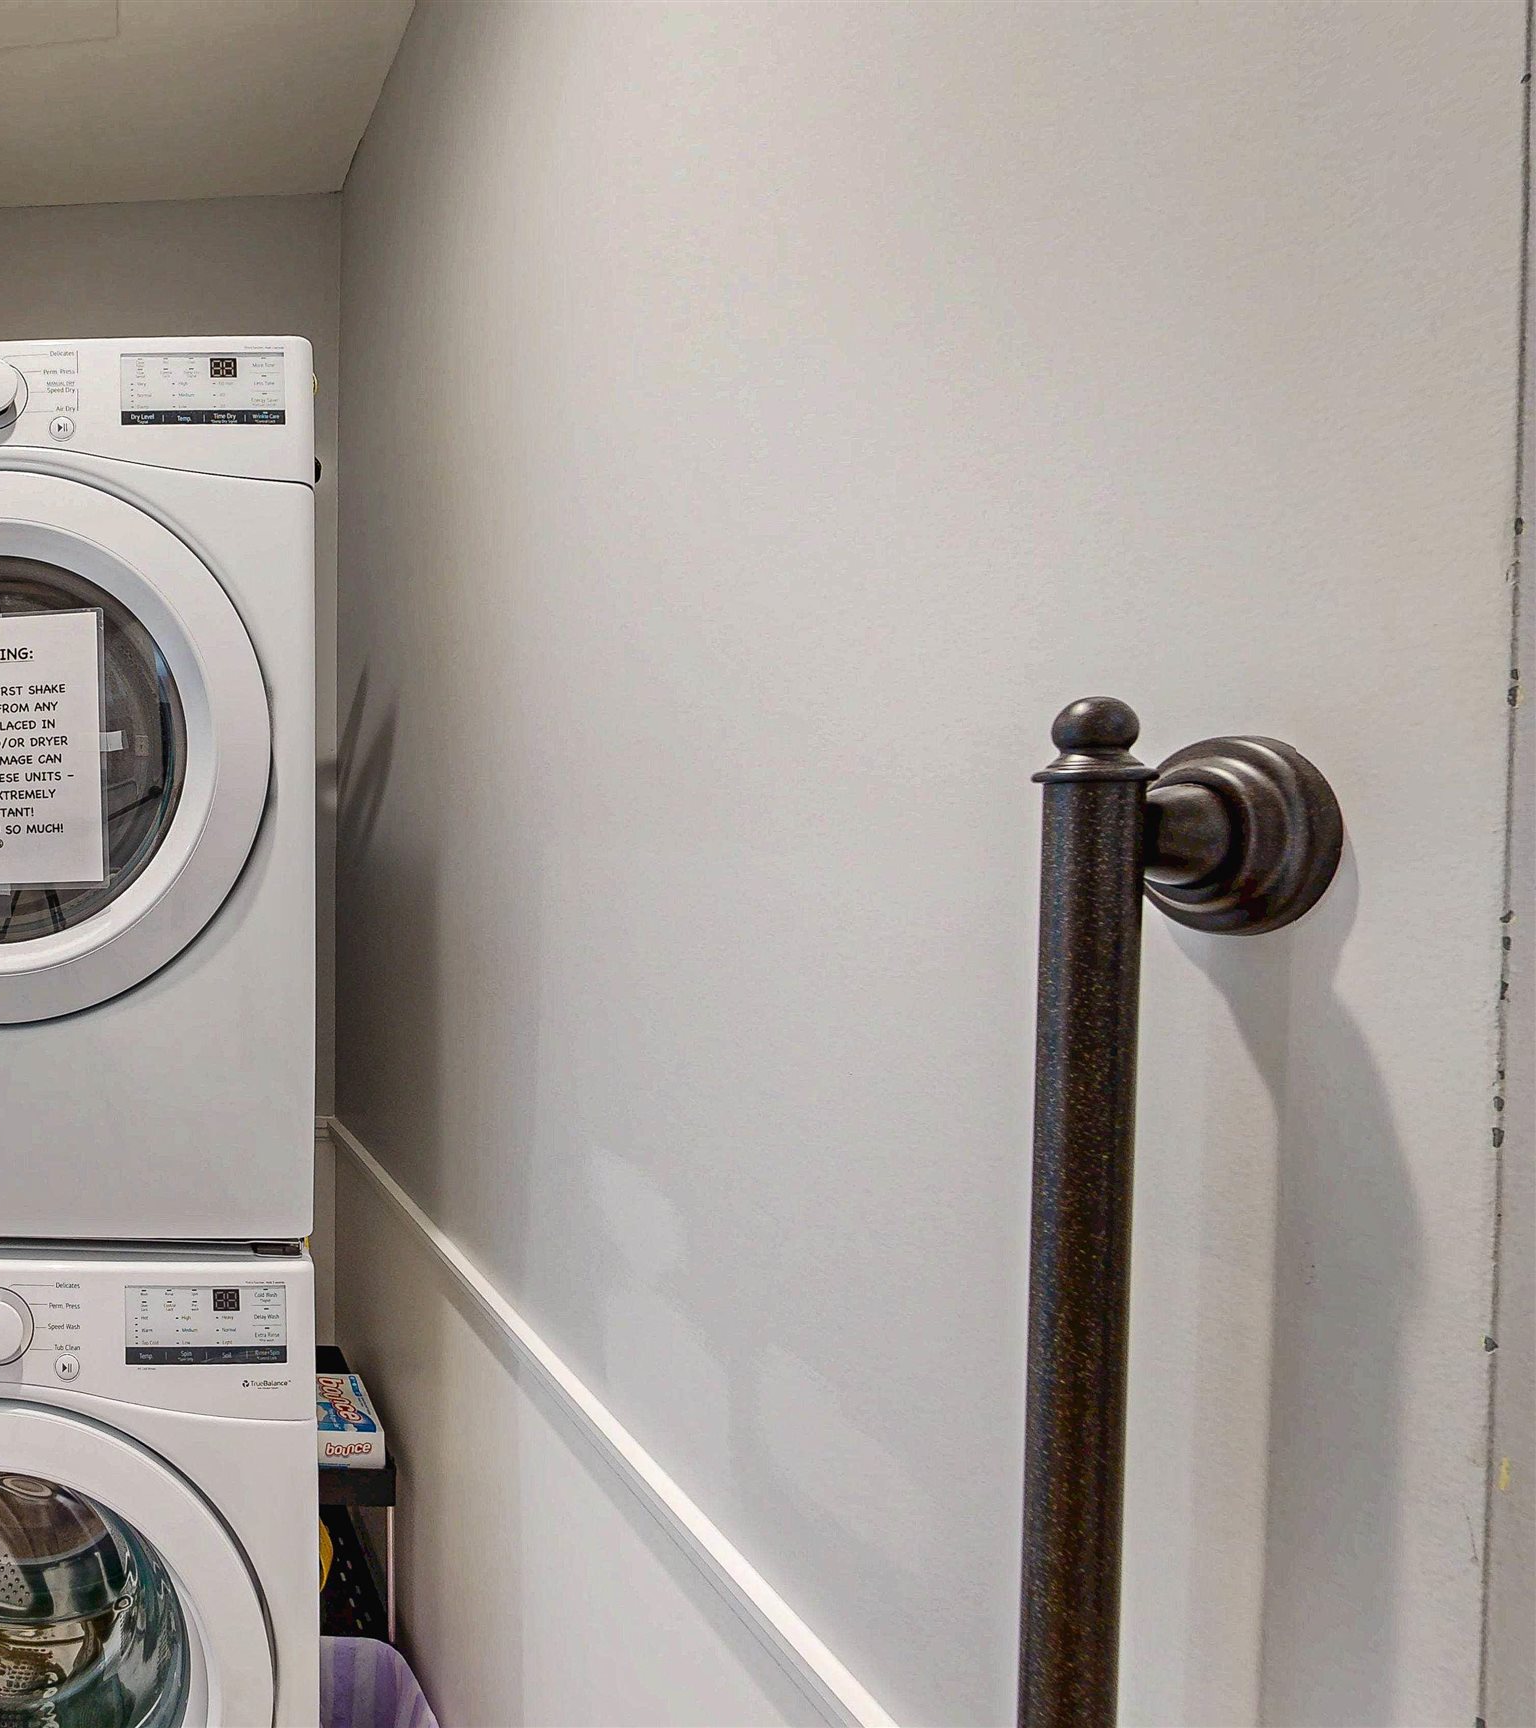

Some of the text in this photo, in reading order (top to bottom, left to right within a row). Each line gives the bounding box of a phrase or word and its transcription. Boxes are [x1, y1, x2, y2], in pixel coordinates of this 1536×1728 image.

[29, 684, 65, 695] SHAKE
[34, 702, 58, 711] ANY
[42, 719, 55, 729] IN
[30, 736, 68, 747] DRYER
[38, 754, 61, 764] CAN
[25, 772, 61, 782] UNITS
[6, 825, 21, 834] SO
[26, 823, 63, 834] MUCH!
[48, 1323, 64, 1331] Speed
[318, 1377, 363, 1422] bounce
[325, 1442, 372, 1457] bounce
